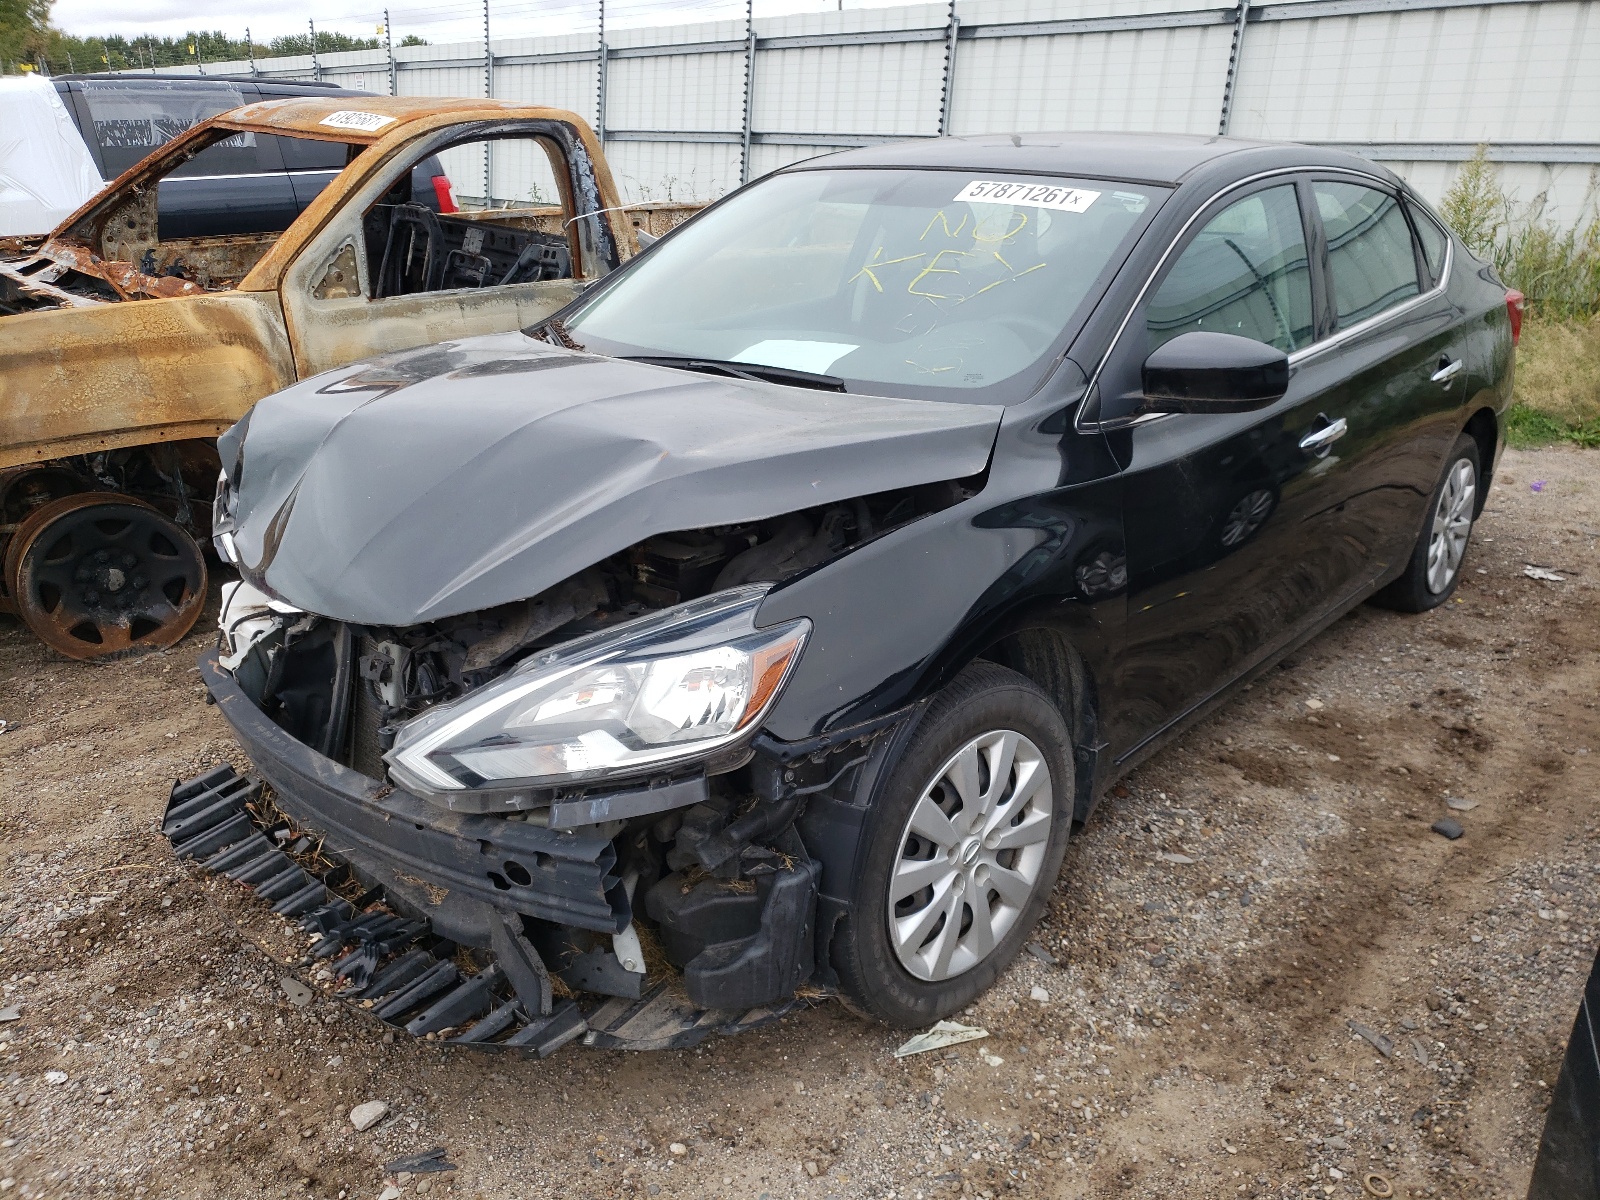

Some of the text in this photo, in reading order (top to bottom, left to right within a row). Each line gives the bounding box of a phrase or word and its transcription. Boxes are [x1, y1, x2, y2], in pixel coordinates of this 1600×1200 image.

[969, 182, 1083, 205] 57871261x
[919, 210, 1028, 242] NO
[848, 246, 1046, 307] KEY
